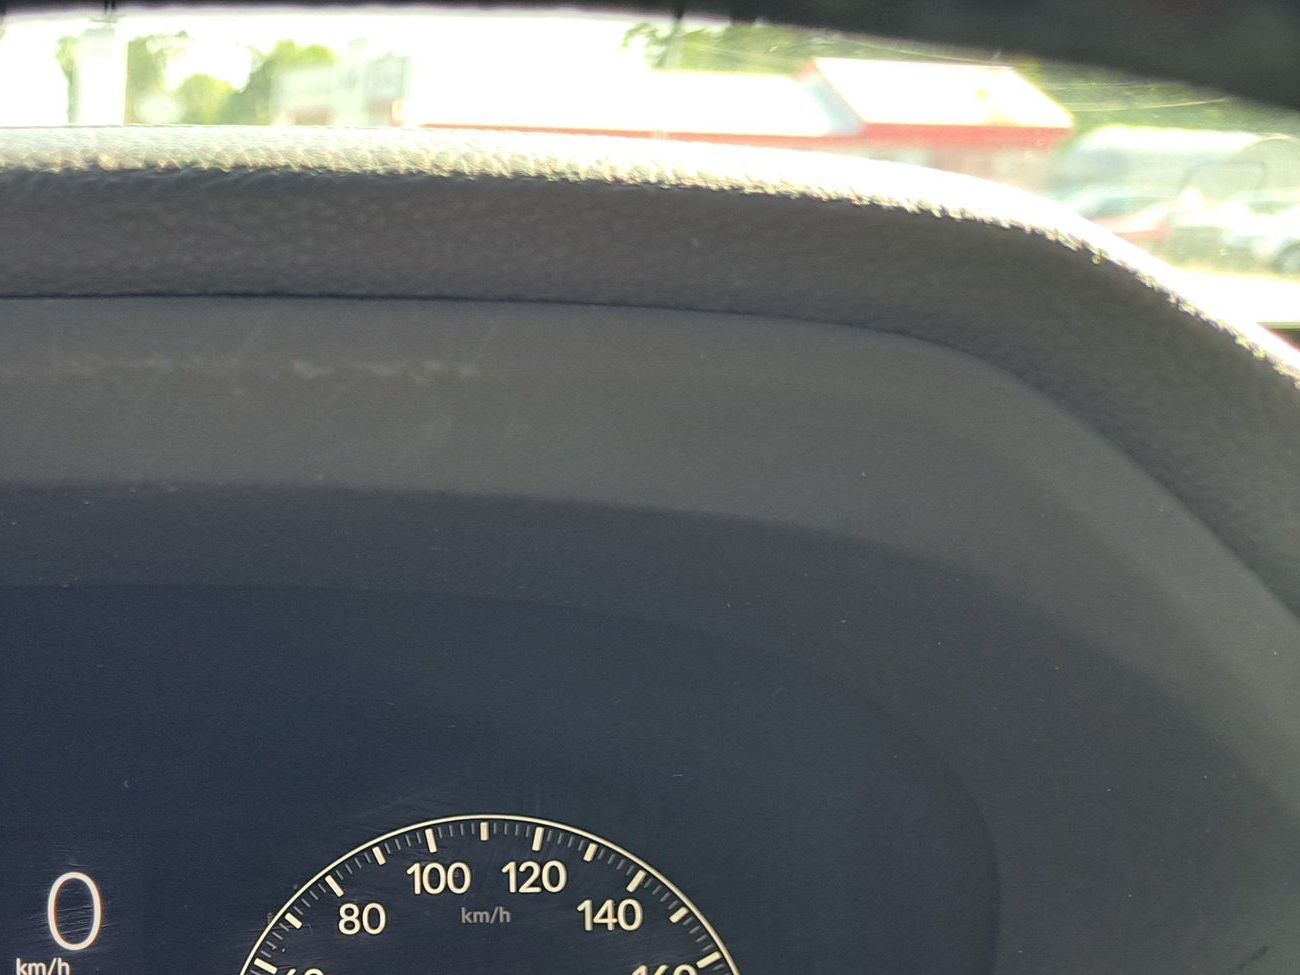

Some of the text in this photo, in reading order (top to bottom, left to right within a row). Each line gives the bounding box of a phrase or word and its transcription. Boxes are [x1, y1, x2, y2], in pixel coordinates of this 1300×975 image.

[407, 863, 470, 894] 100
[502, 861, 566, 892] 120
[48, 872, 101, 950] 0
[339, 903, 385, 934] 80
[462, 907, 510, 923] km/h
[577, 899, 641, 930] 140
